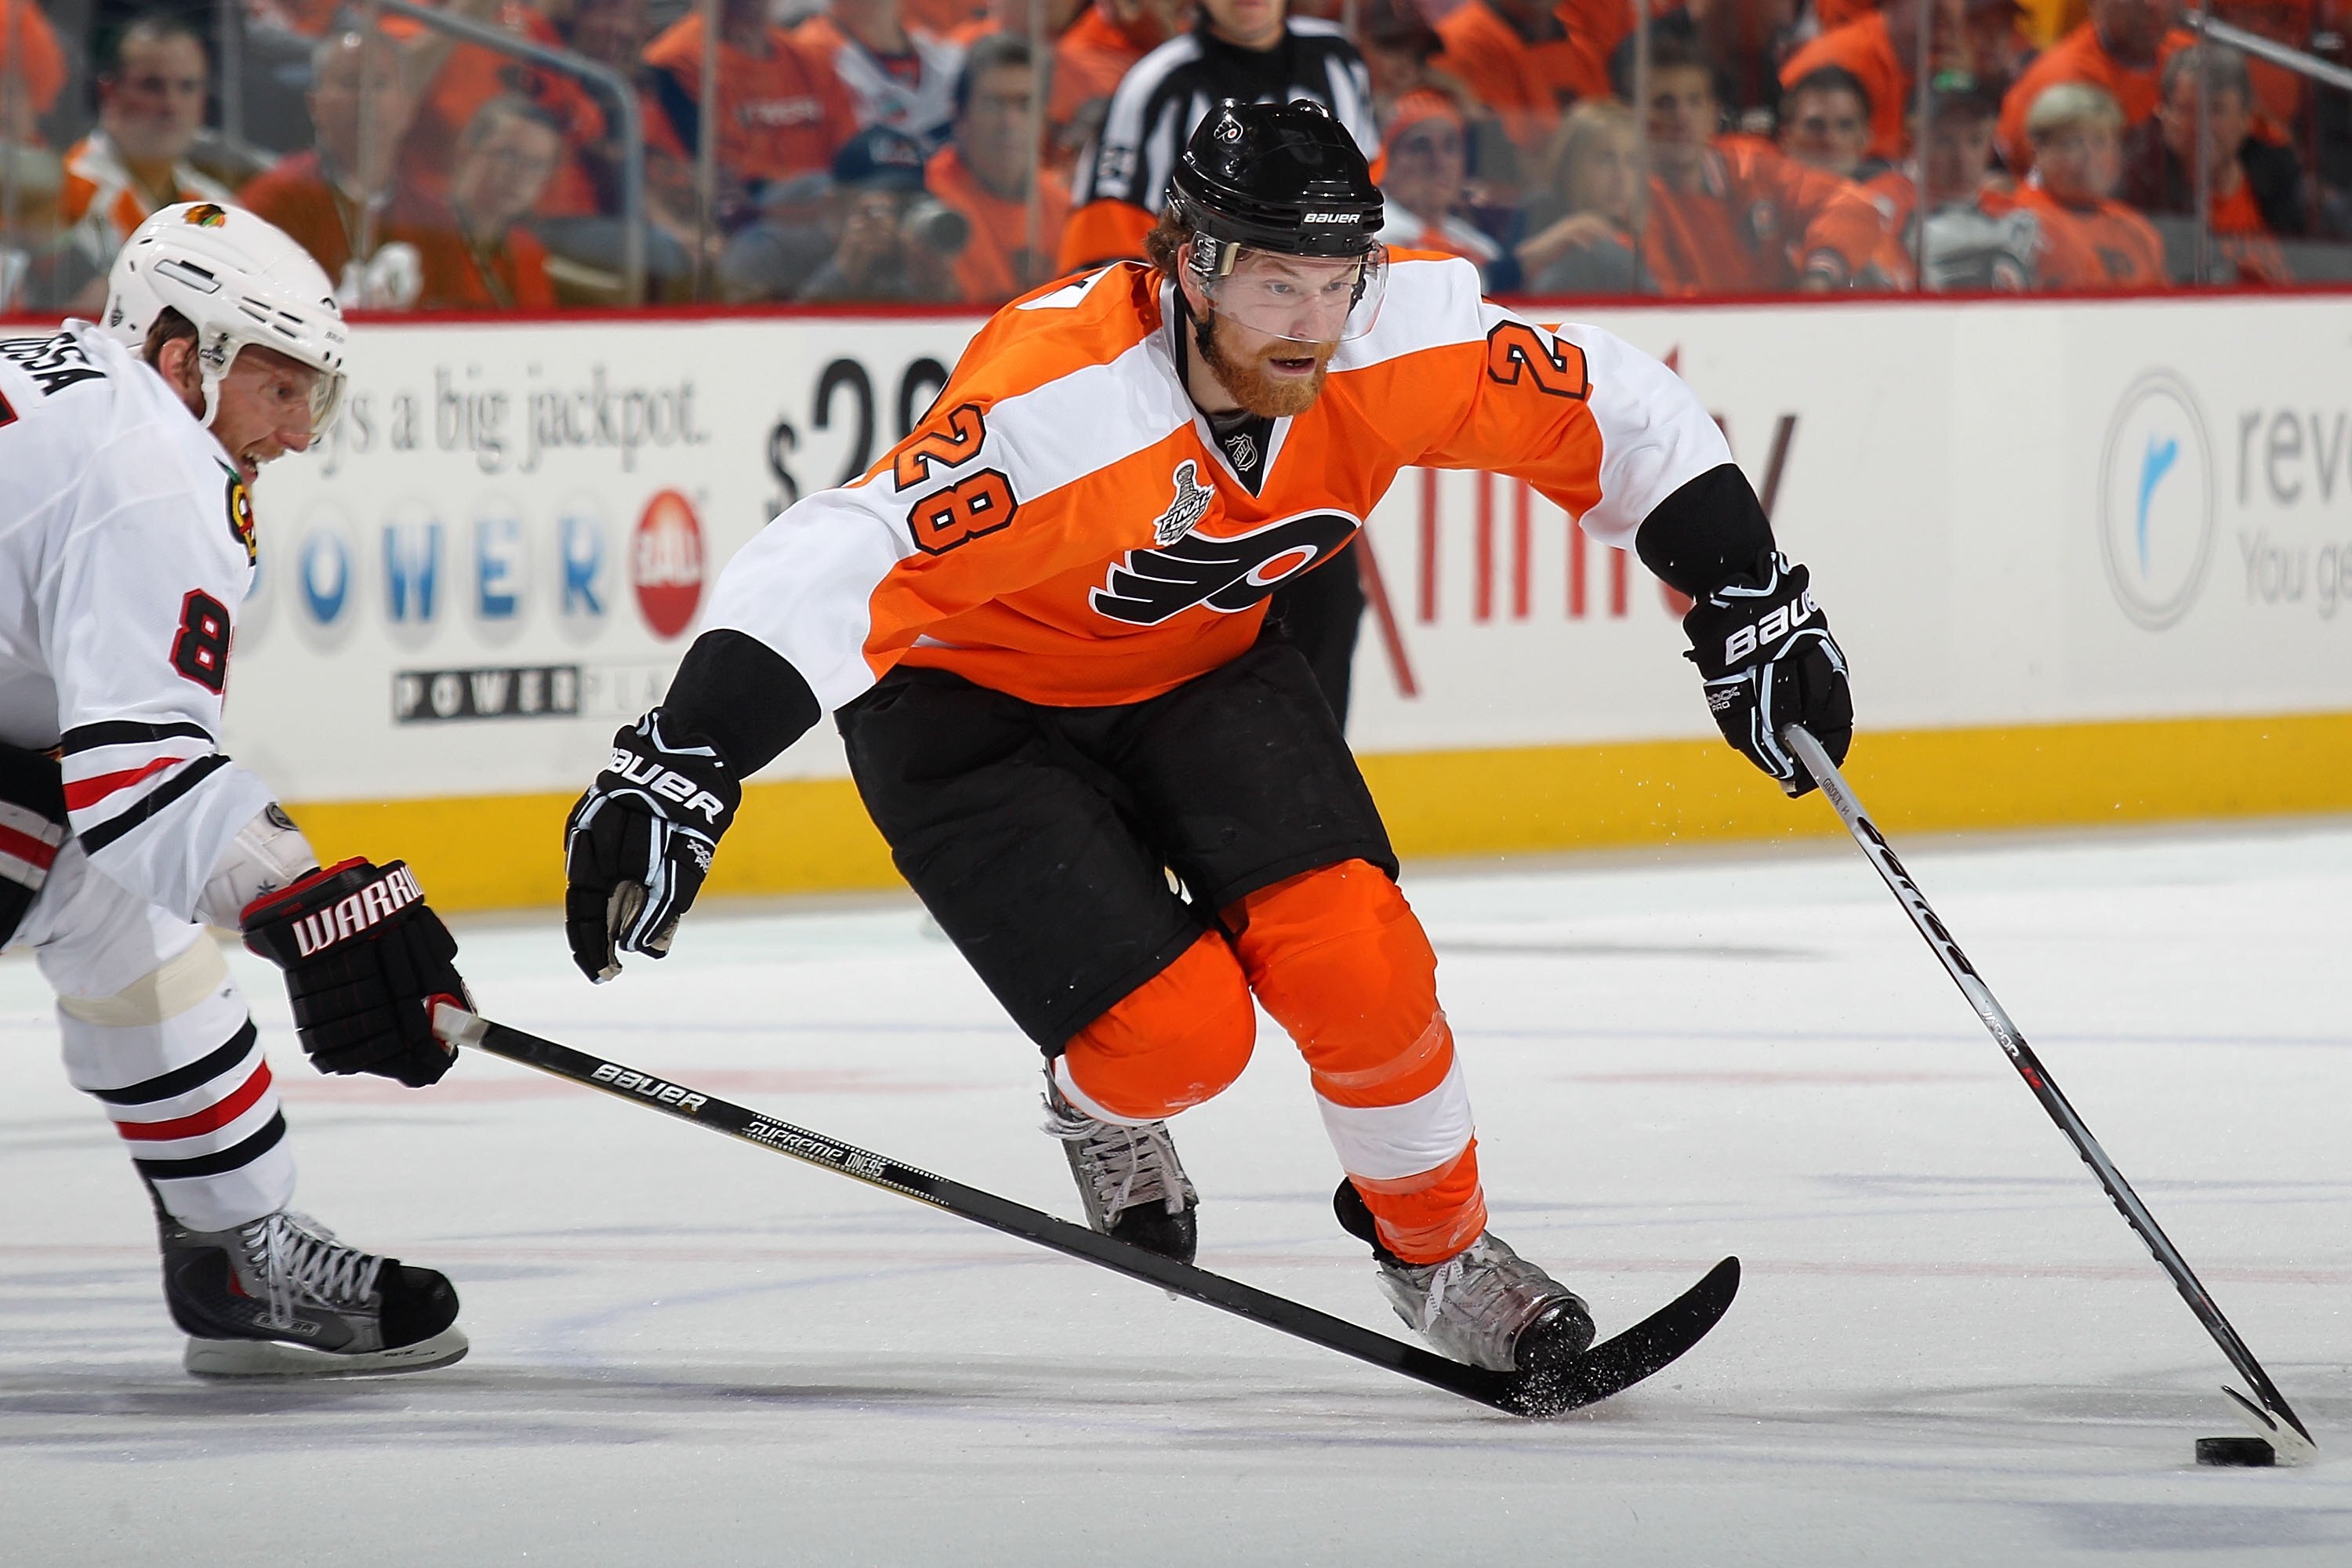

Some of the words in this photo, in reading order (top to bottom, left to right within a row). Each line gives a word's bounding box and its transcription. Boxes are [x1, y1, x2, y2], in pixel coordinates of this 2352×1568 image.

[1304, 213, 1360, 223] BAUER
[0, 332, 107, 397] OSSA
[392, 394, 419, 451] a
[435, 367, 508, 474] big
[520, 362, 710, 474] jackpot.
[1234, 440, 1253, 465] NHL
[894, 403, 1018, 556] 28
[2236, 409, 2352, 506] rev
[1161, 494, 1208, 532] FINAL
[249, 516, 605, 626] OWER
[169, 588, 230, 696] 8
[1725, 590, 1818, 666] BAU
[397, 671, 576, 718] POWER
[610, 747, 724, 824] AUER
[1823, 778, 1843, 806] GIROUX
[291, 864, 424, 958] WARRI
[590, 1063, 708, 1112] BAUER
[742, 1121, 844, 1161] SUPREME
